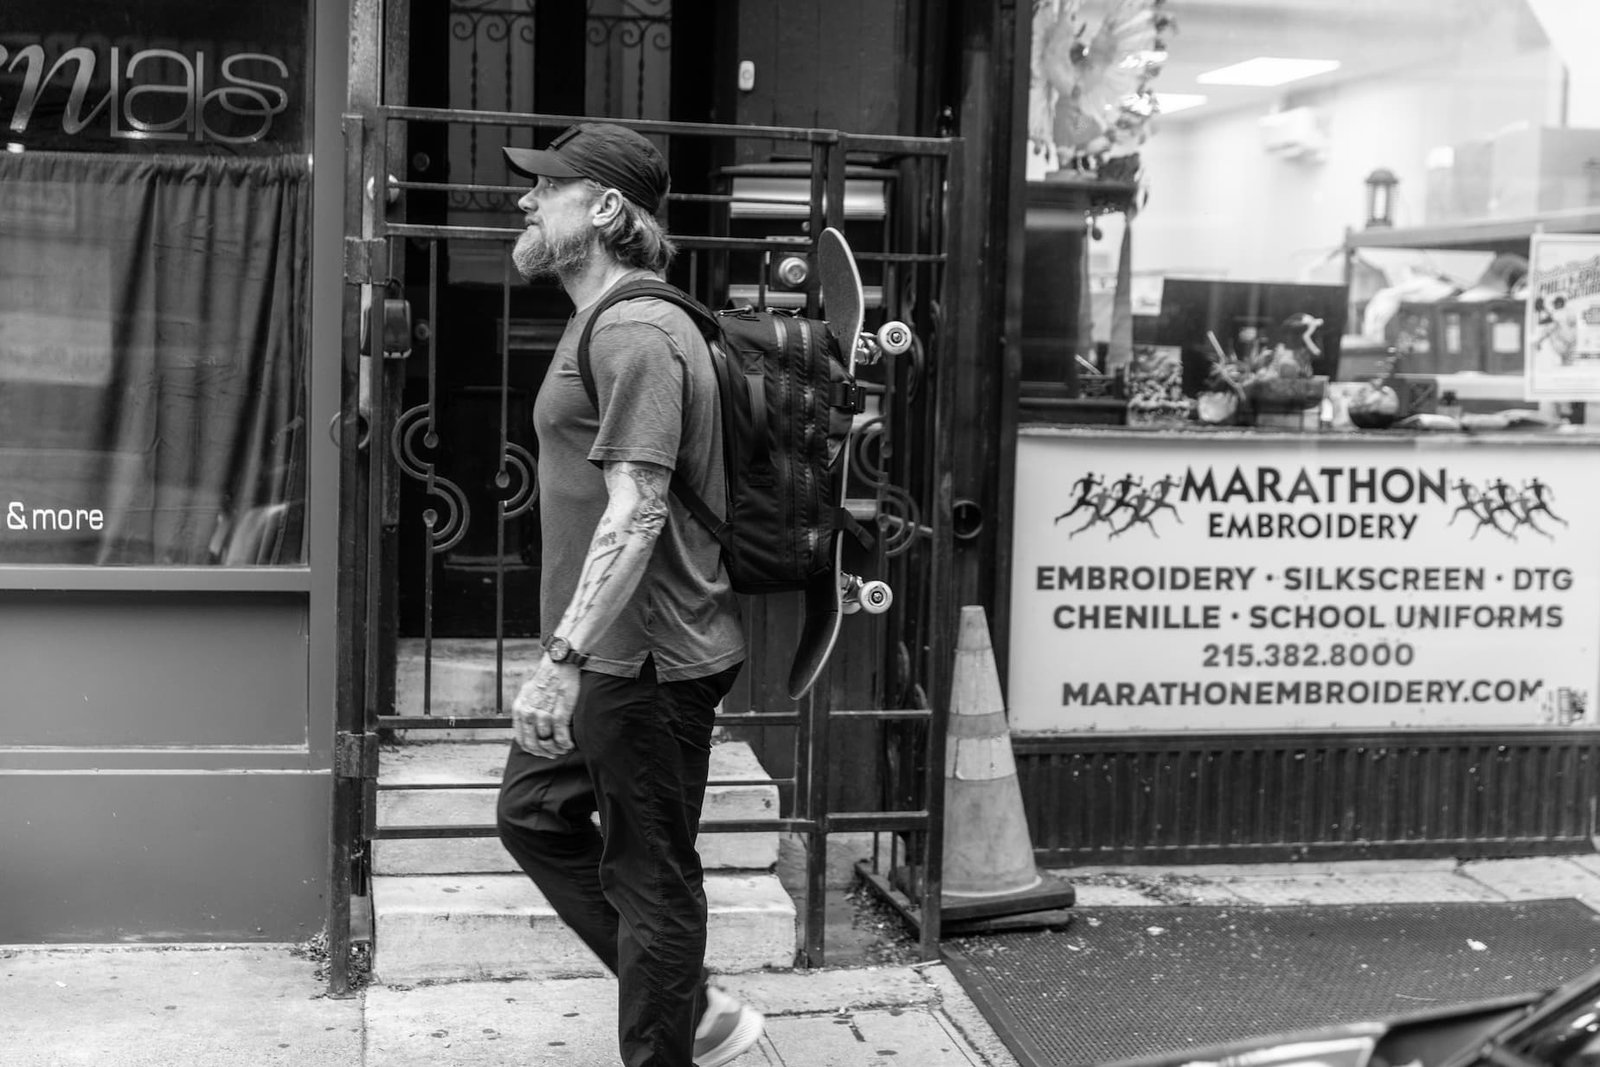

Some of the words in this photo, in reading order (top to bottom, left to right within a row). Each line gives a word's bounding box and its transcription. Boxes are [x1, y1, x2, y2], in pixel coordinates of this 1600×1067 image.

[1180, 466, 1447, 504] MARATHON
[6, 501, 28, 530] &
[32, 508, 104, 531] more
[1208, 512, 1418, 540] EMBROIDERY
[1036, 565, 1255, 591] EMBROIDERY
[1284, 567, 1484, 591] SILKSCREEN
[1514, 568, 1574, 591] DTG
[1053, 605, 1220, 629] CHENILLE
[1249, 605, 1386, 629] SCHOOL
[1396, 605, 1563, 629] UNIFORMS
[1203, 644, 1414, 667] 215.382.8000
[1062, 680, 1543, 706] MARATHONEMBROIDERY.COM
